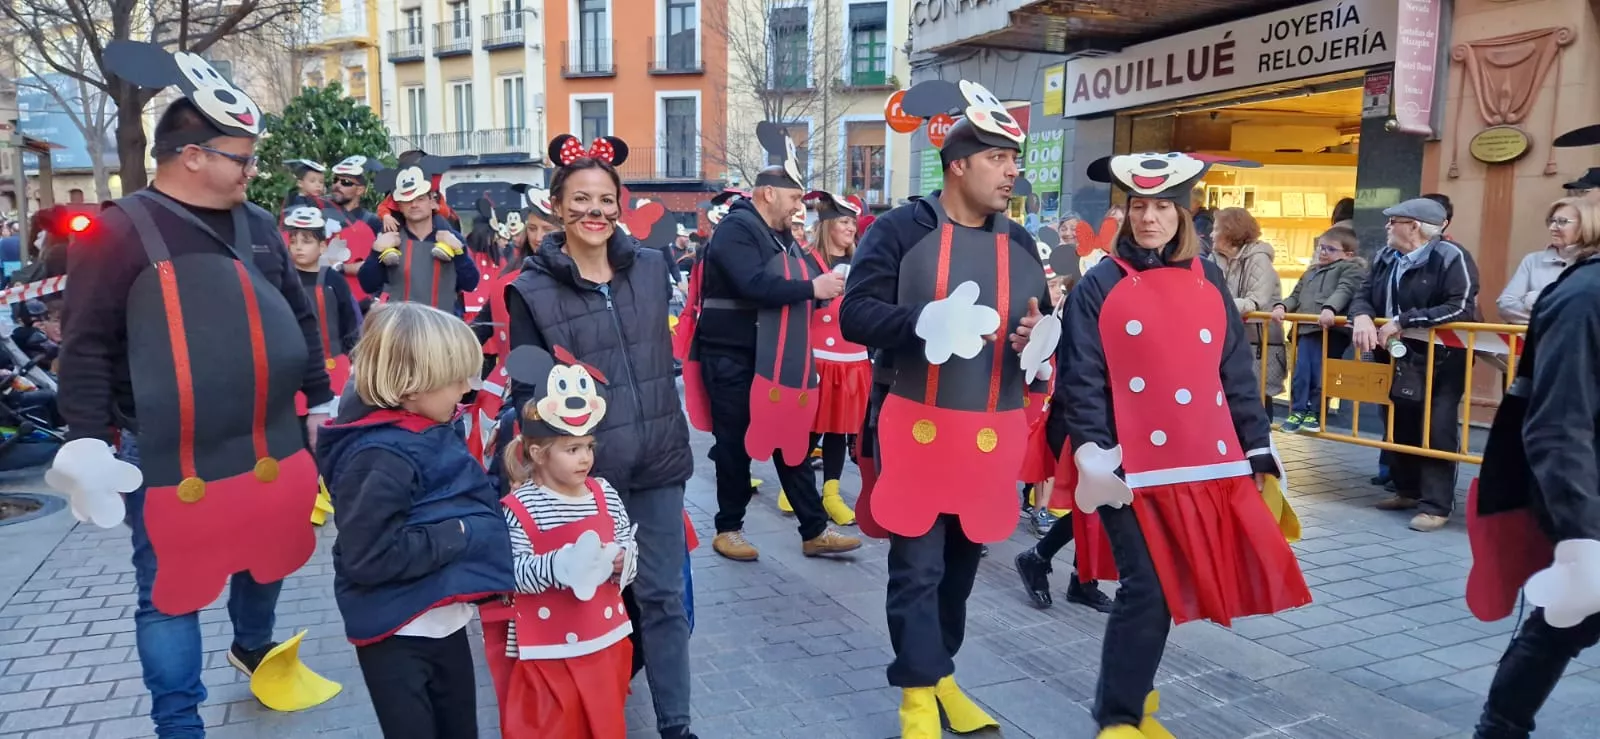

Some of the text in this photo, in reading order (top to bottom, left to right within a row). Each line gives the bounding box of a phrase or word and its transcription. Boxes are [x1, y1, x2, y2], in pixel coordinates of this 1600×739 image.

[1261, 3, 1360, 44] JOYERÍA
[1072, 30, 1236, 104] AQUILLUÉ
[1259, 29, 1387, 73] RELOJERÍA
